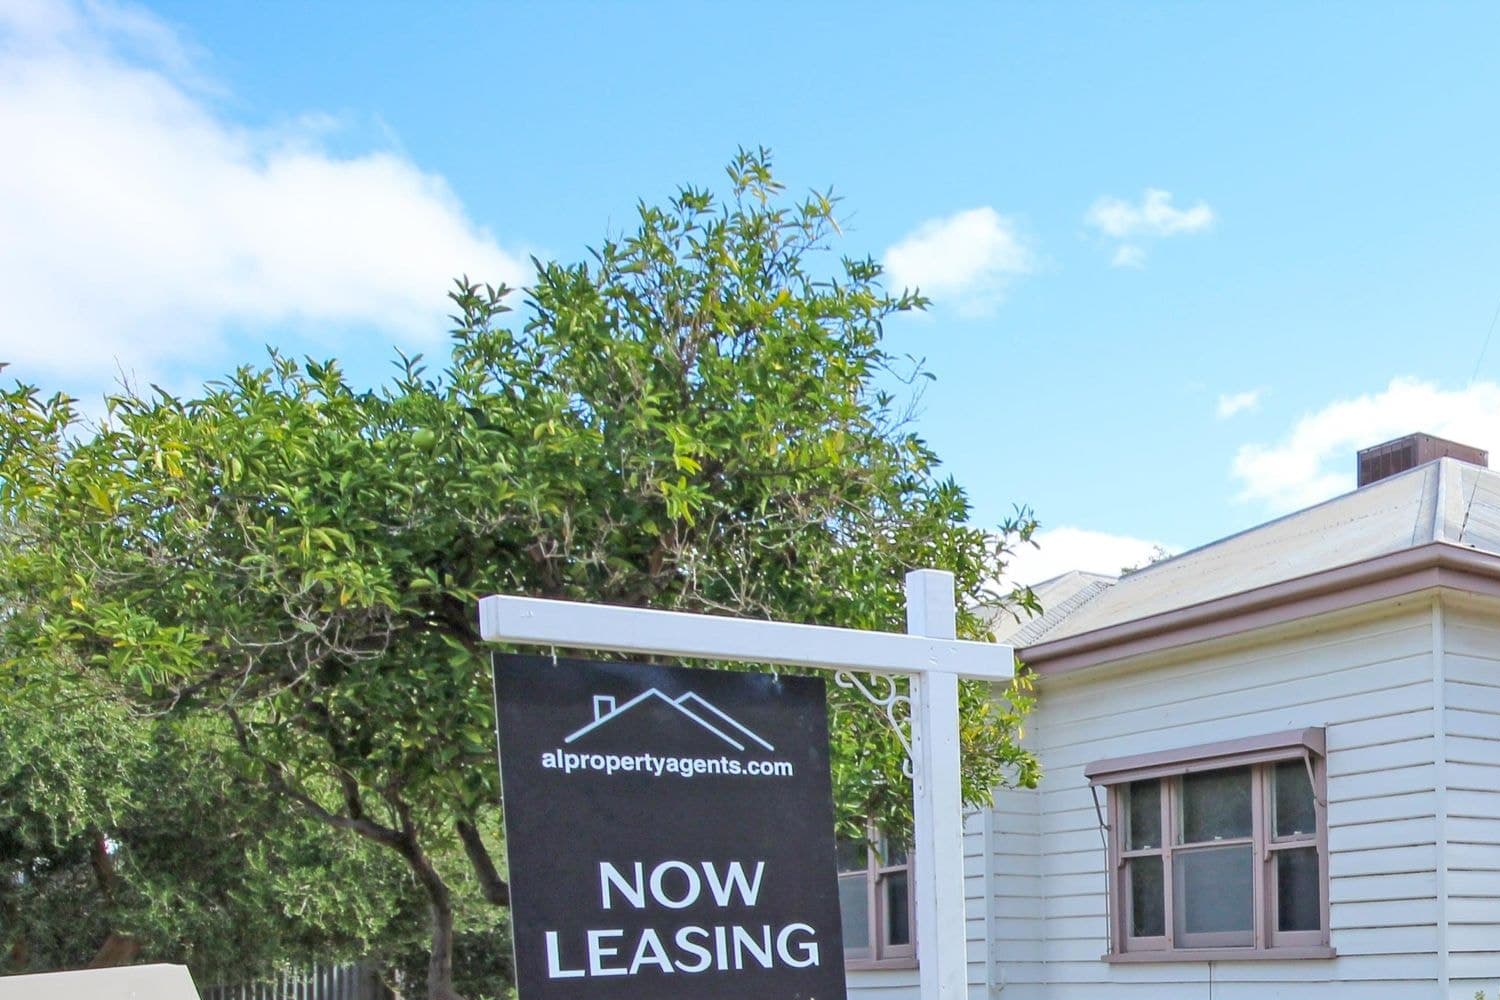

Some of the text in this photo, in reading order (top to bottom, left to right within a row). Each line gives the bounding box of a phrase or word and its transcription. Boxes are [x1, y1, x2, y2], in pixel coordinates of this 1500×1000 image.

[542, 749, 793, 777] alpropertyagents.com
[599, 860, 765, 909] NOW
[545, 923, 819, 979] LEASING
